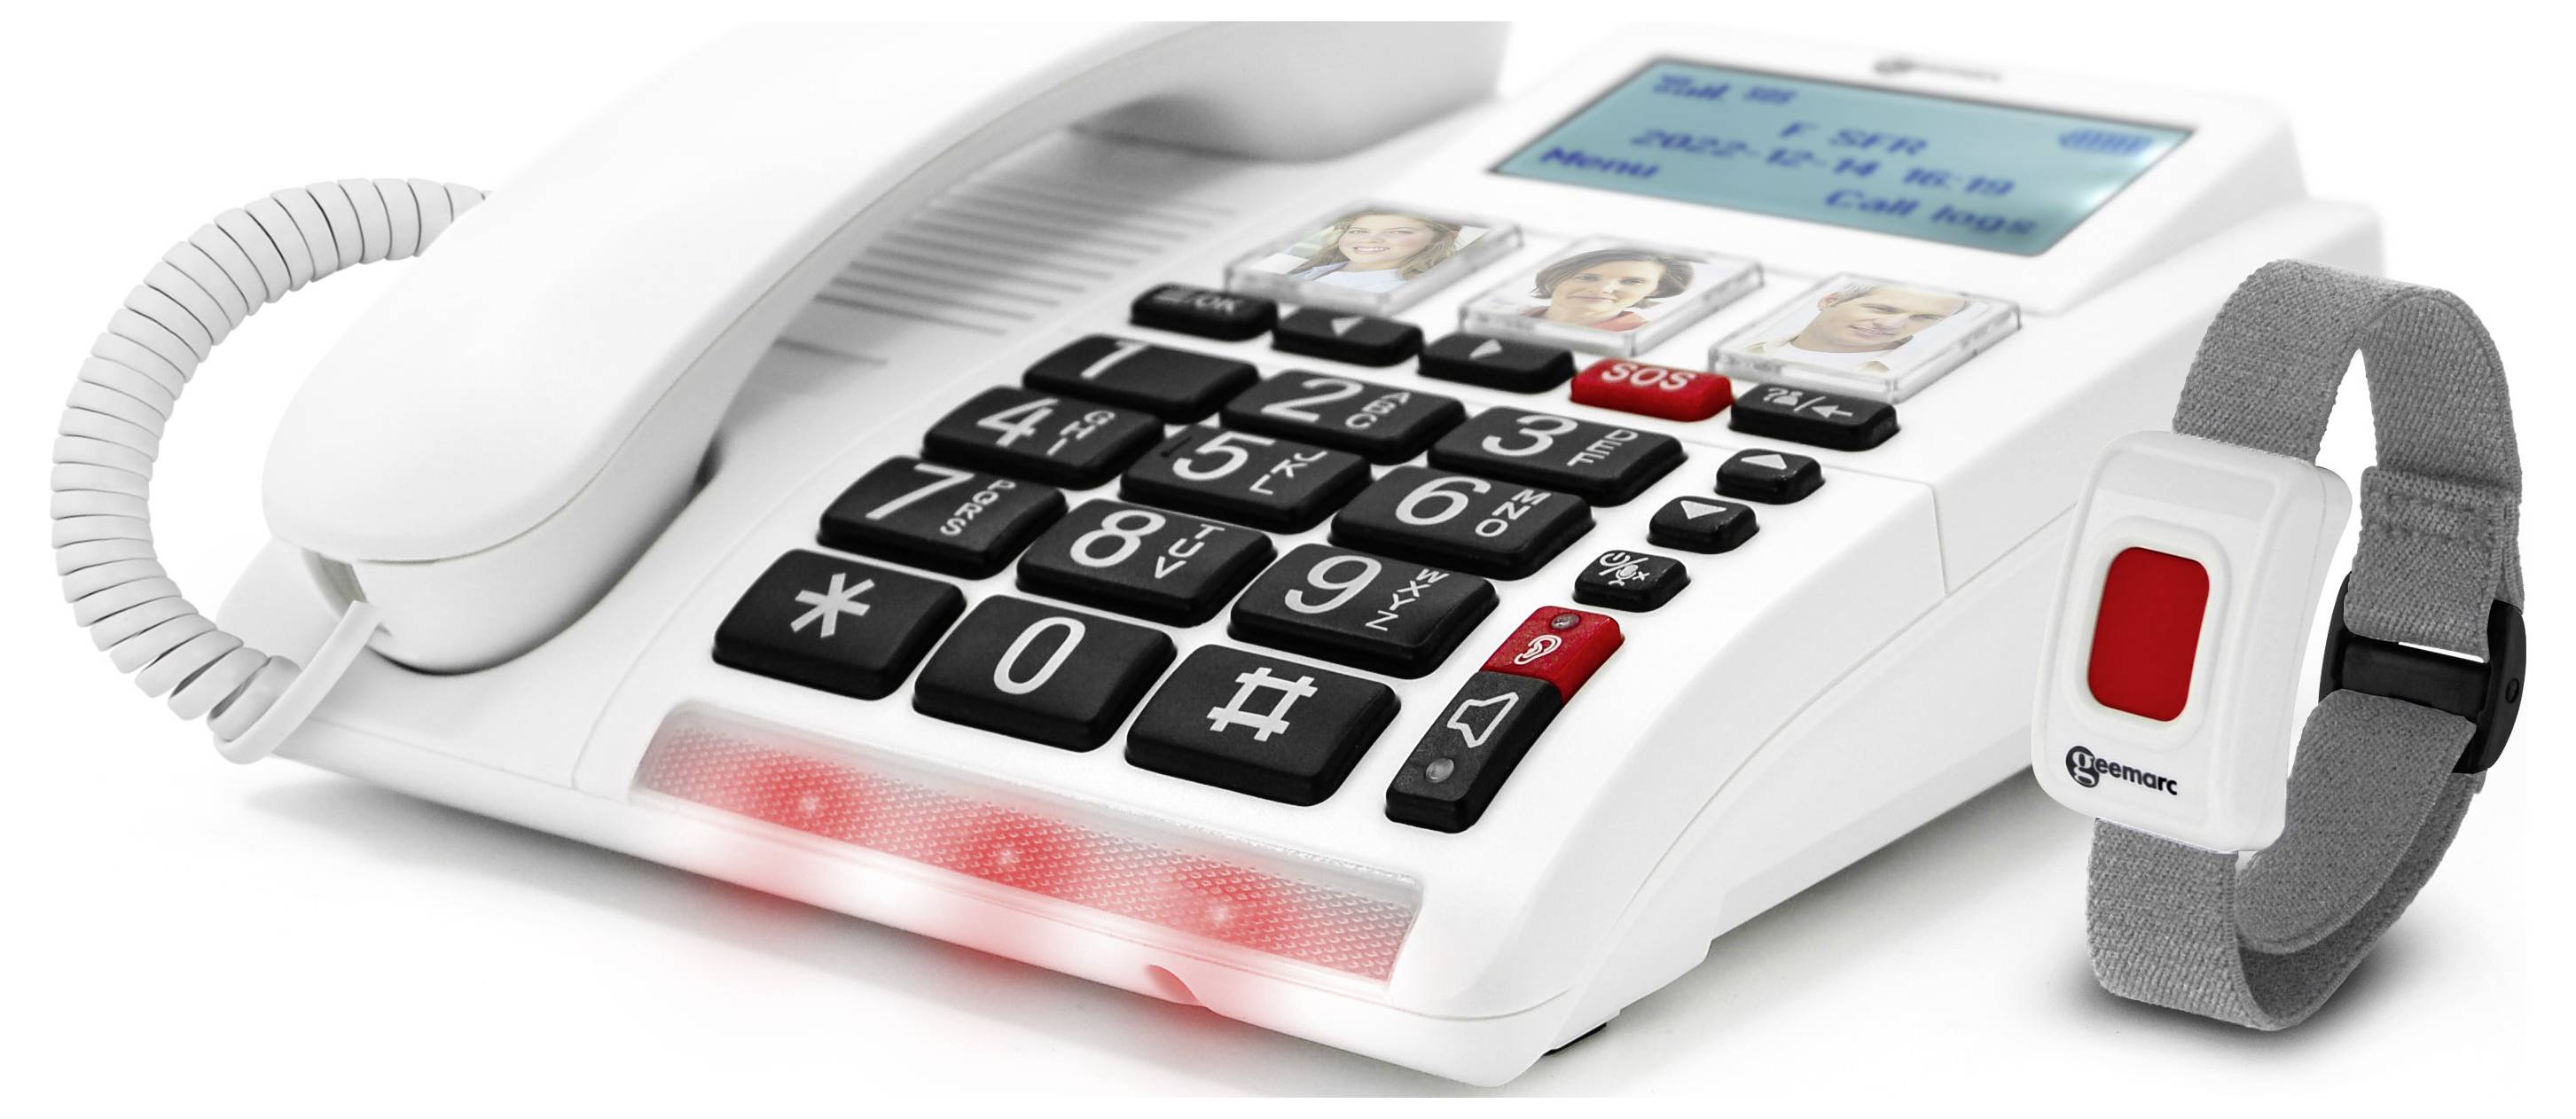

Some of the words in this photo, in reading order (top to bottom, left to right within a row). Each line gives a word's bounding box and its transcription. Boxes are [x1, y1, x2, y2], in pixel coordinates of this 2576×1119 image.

[1540, 146, 1659, 178] Menu
[1828, 129, 1928, 157] SFR
[1824, 188, 1919, 217] Call
[1930, 203, 2038, 235] logs
[1079, 339, 1151, 380] 1
[1601, 362, 1697, 391] SOS
[975, 397, 1061, 448] 4
[1261, 378, 1365, 423] 2
[1172, 430, 1276, 481] 5
[1482, 414, 1578, 458] 3
[865, 462, 975, 520] 7
[1395, 476, 1492, 526] 6
[1069, 509, 1167, 568] 8
[1284, 554, 1382, 614] 9
[993, 616, 1086, 695] 0
[2065, 745, 2179, 796] geemarc
